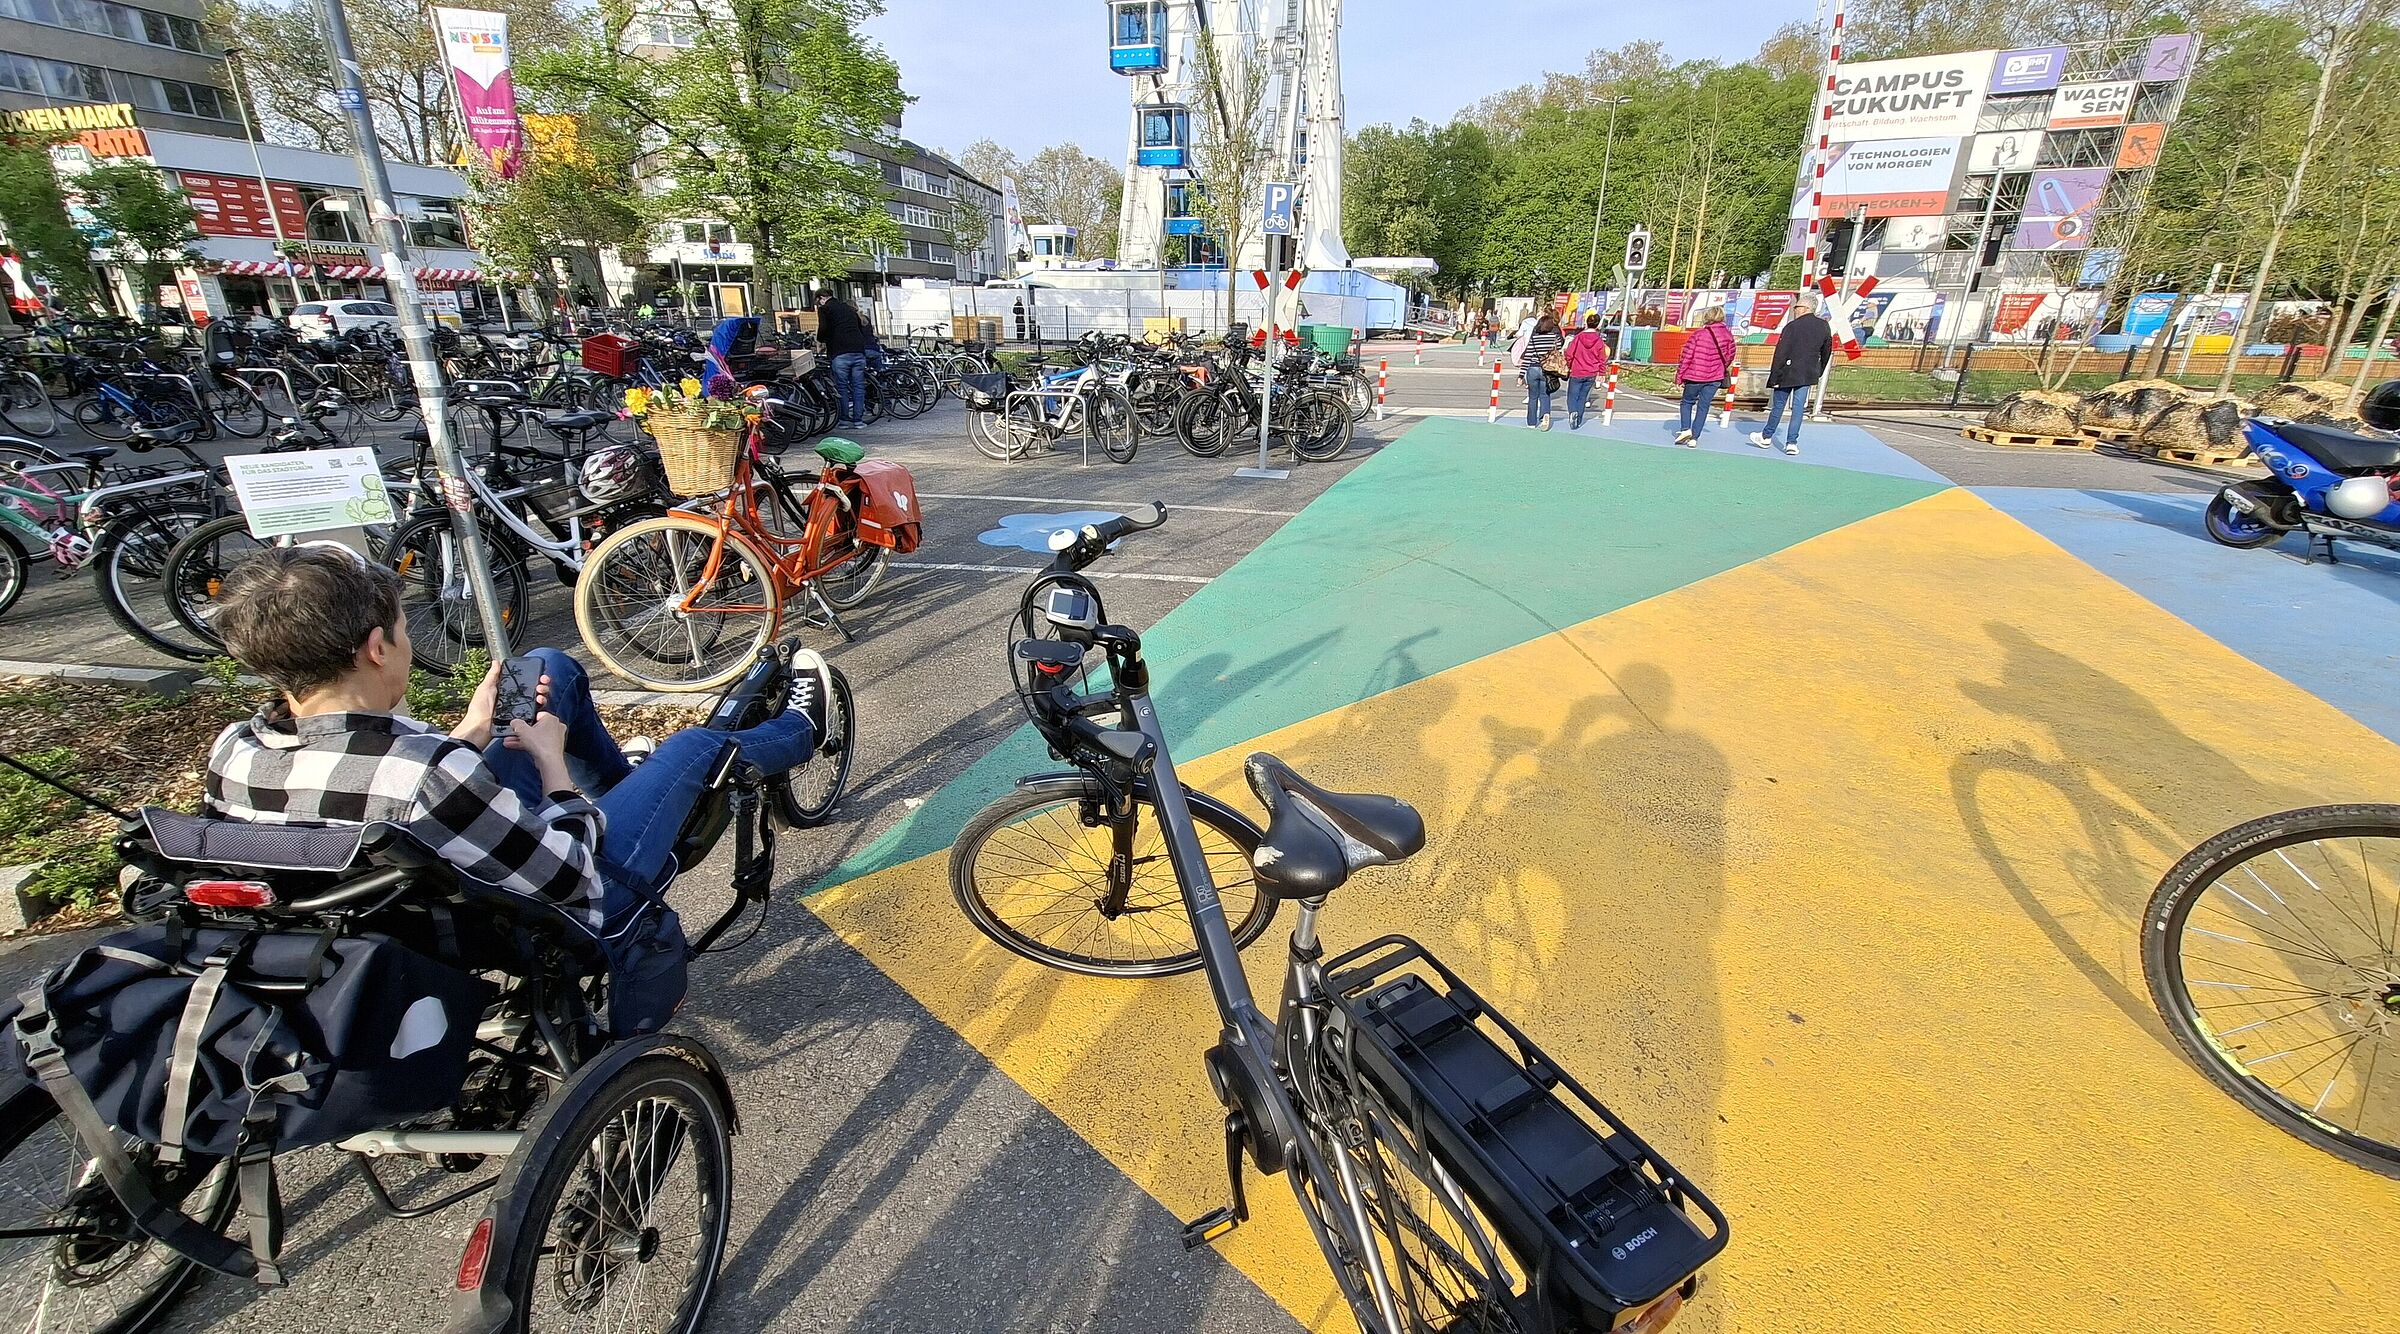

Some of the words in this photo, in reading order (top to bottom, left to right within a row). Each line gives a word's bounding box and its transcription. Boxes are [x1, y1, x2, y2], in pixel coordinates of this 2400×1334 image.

[449, 32, 501, 44] NEUSS
[2028, 57, 2047, 65] IHK
[1834, 70, 1964, 96] CAMPUS
[1832, 90, 1973, 116] ZUKUNFT
[2064, 86, 2130, 101] WACH
[2081, 100, 2125, 113] SEN
[1850, 147, 1951, 160] TECHNOLOGIEN
[1848, 162, 1874, 171] VON
[1876, 159, 1932, 169] MORGEN
[1271, 186, 1287, 211] P
[1829, 198, 1922, 210] ENTECKEN
[2220, 829, 2283, 858] SMART
[2184, 858, 2216, 882] SAM
[2160, 884, 2185, 918] PLUS
[1624, 1226, 1658, 1252] BOSCH
